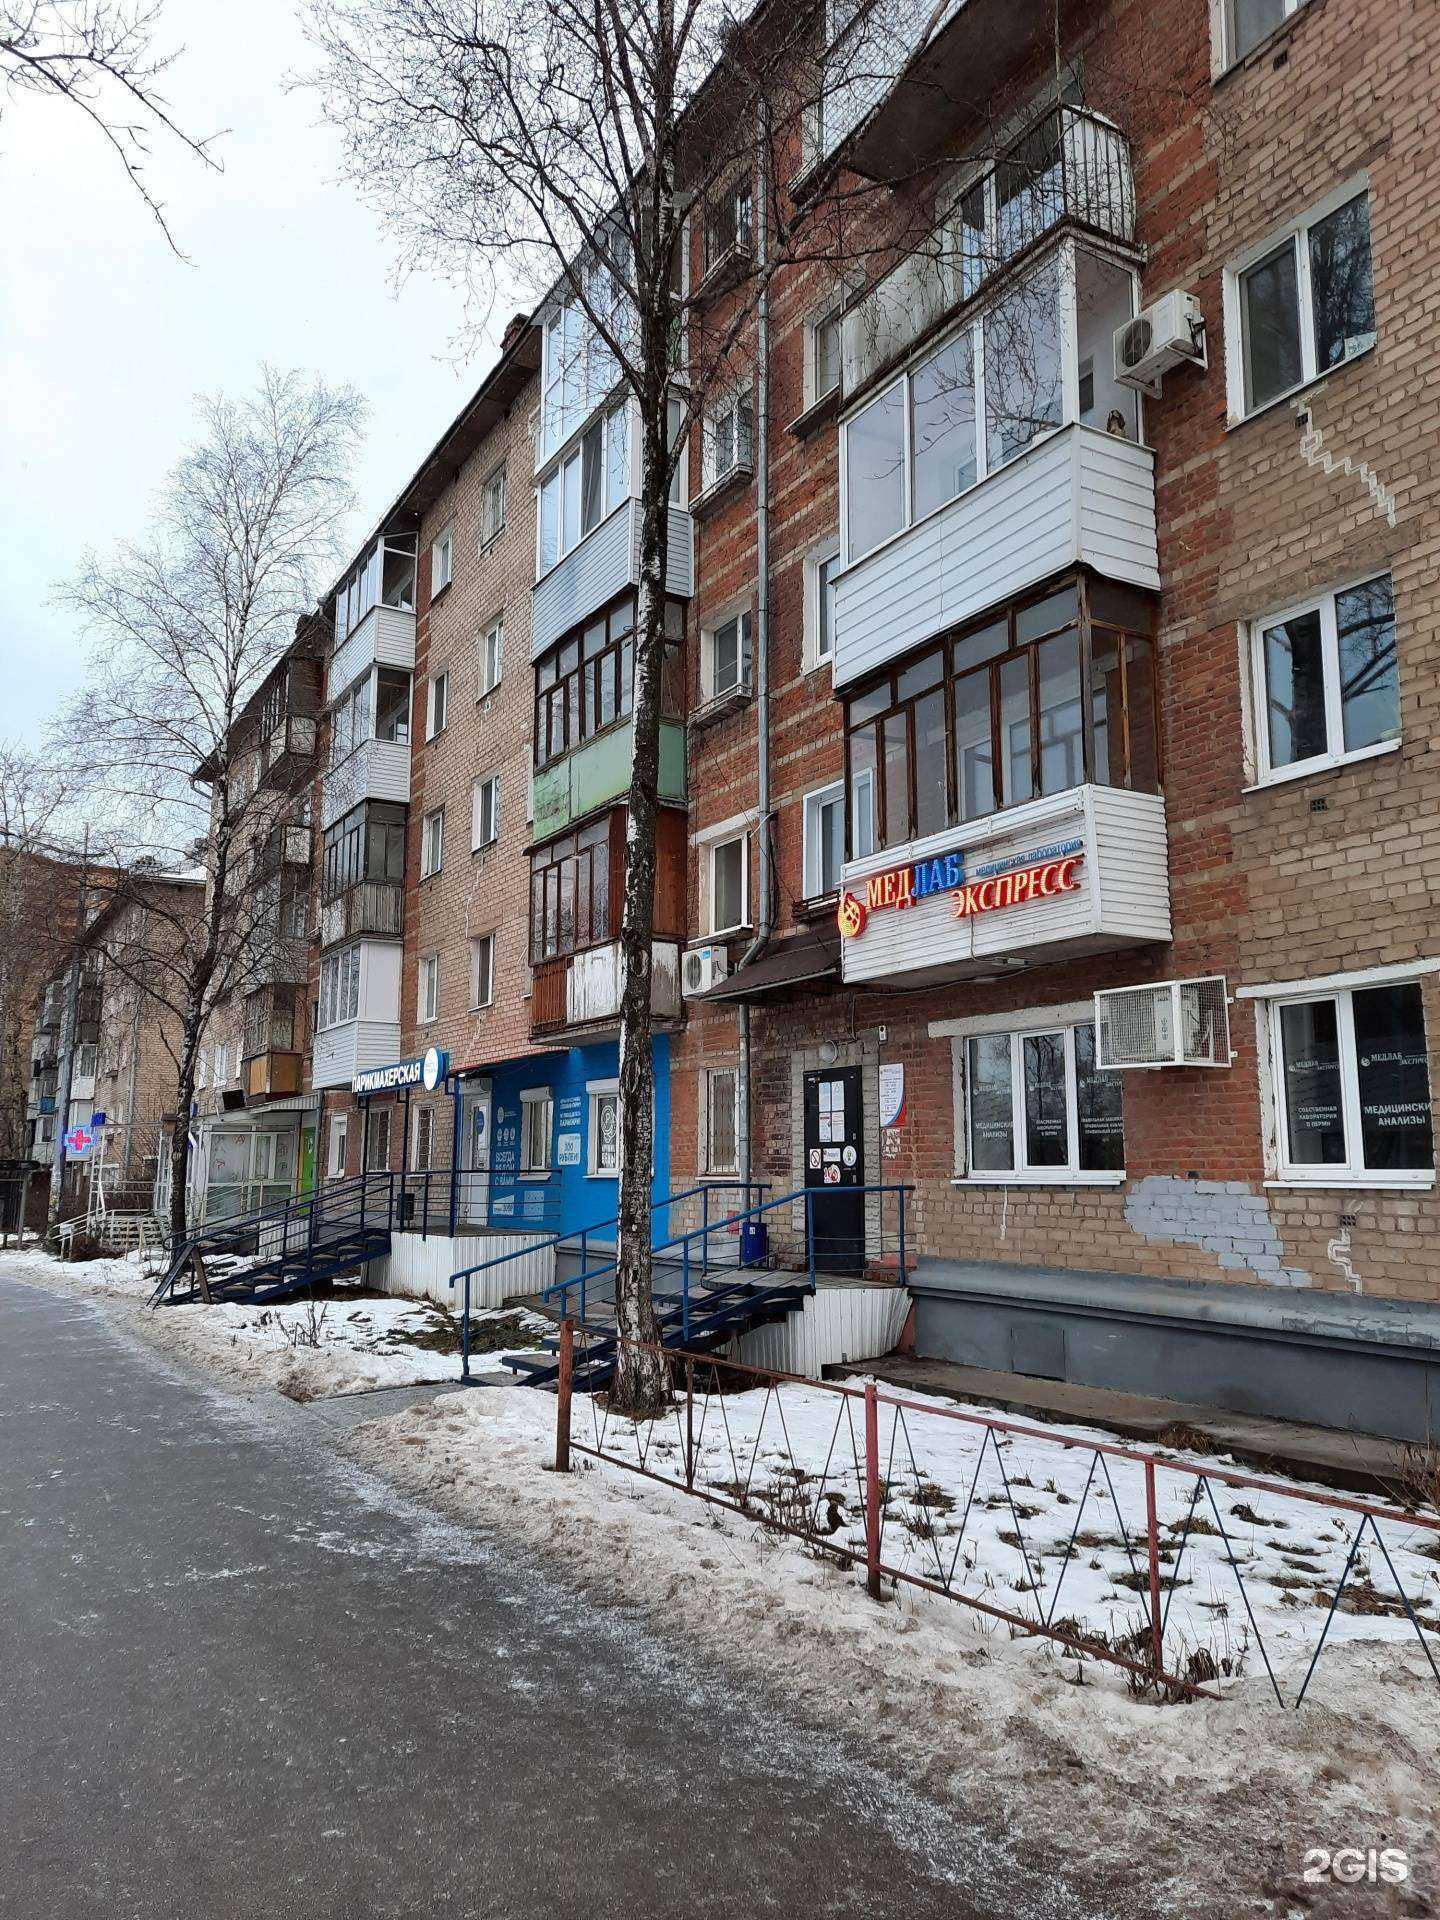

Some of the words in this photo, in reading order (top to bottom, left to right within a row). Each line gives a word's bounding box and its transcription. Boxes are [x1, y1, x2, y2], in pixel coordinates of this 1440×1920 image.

[865, 853, 965, 909] МЕДЛАБ
[951, 858, 1083, 918] ЭКСПРЕСС
[1371, 1052, 1402, 1061] МЕДЛАБ
[352, 1062, 420, 1093] ПАРИКМАХЕРСКАЯ
[1364, 1102, 1432, 1114] МЕДИЦИНСКИ
[1378, 1115, 1426, 1126] АНАЛИЗЫ
